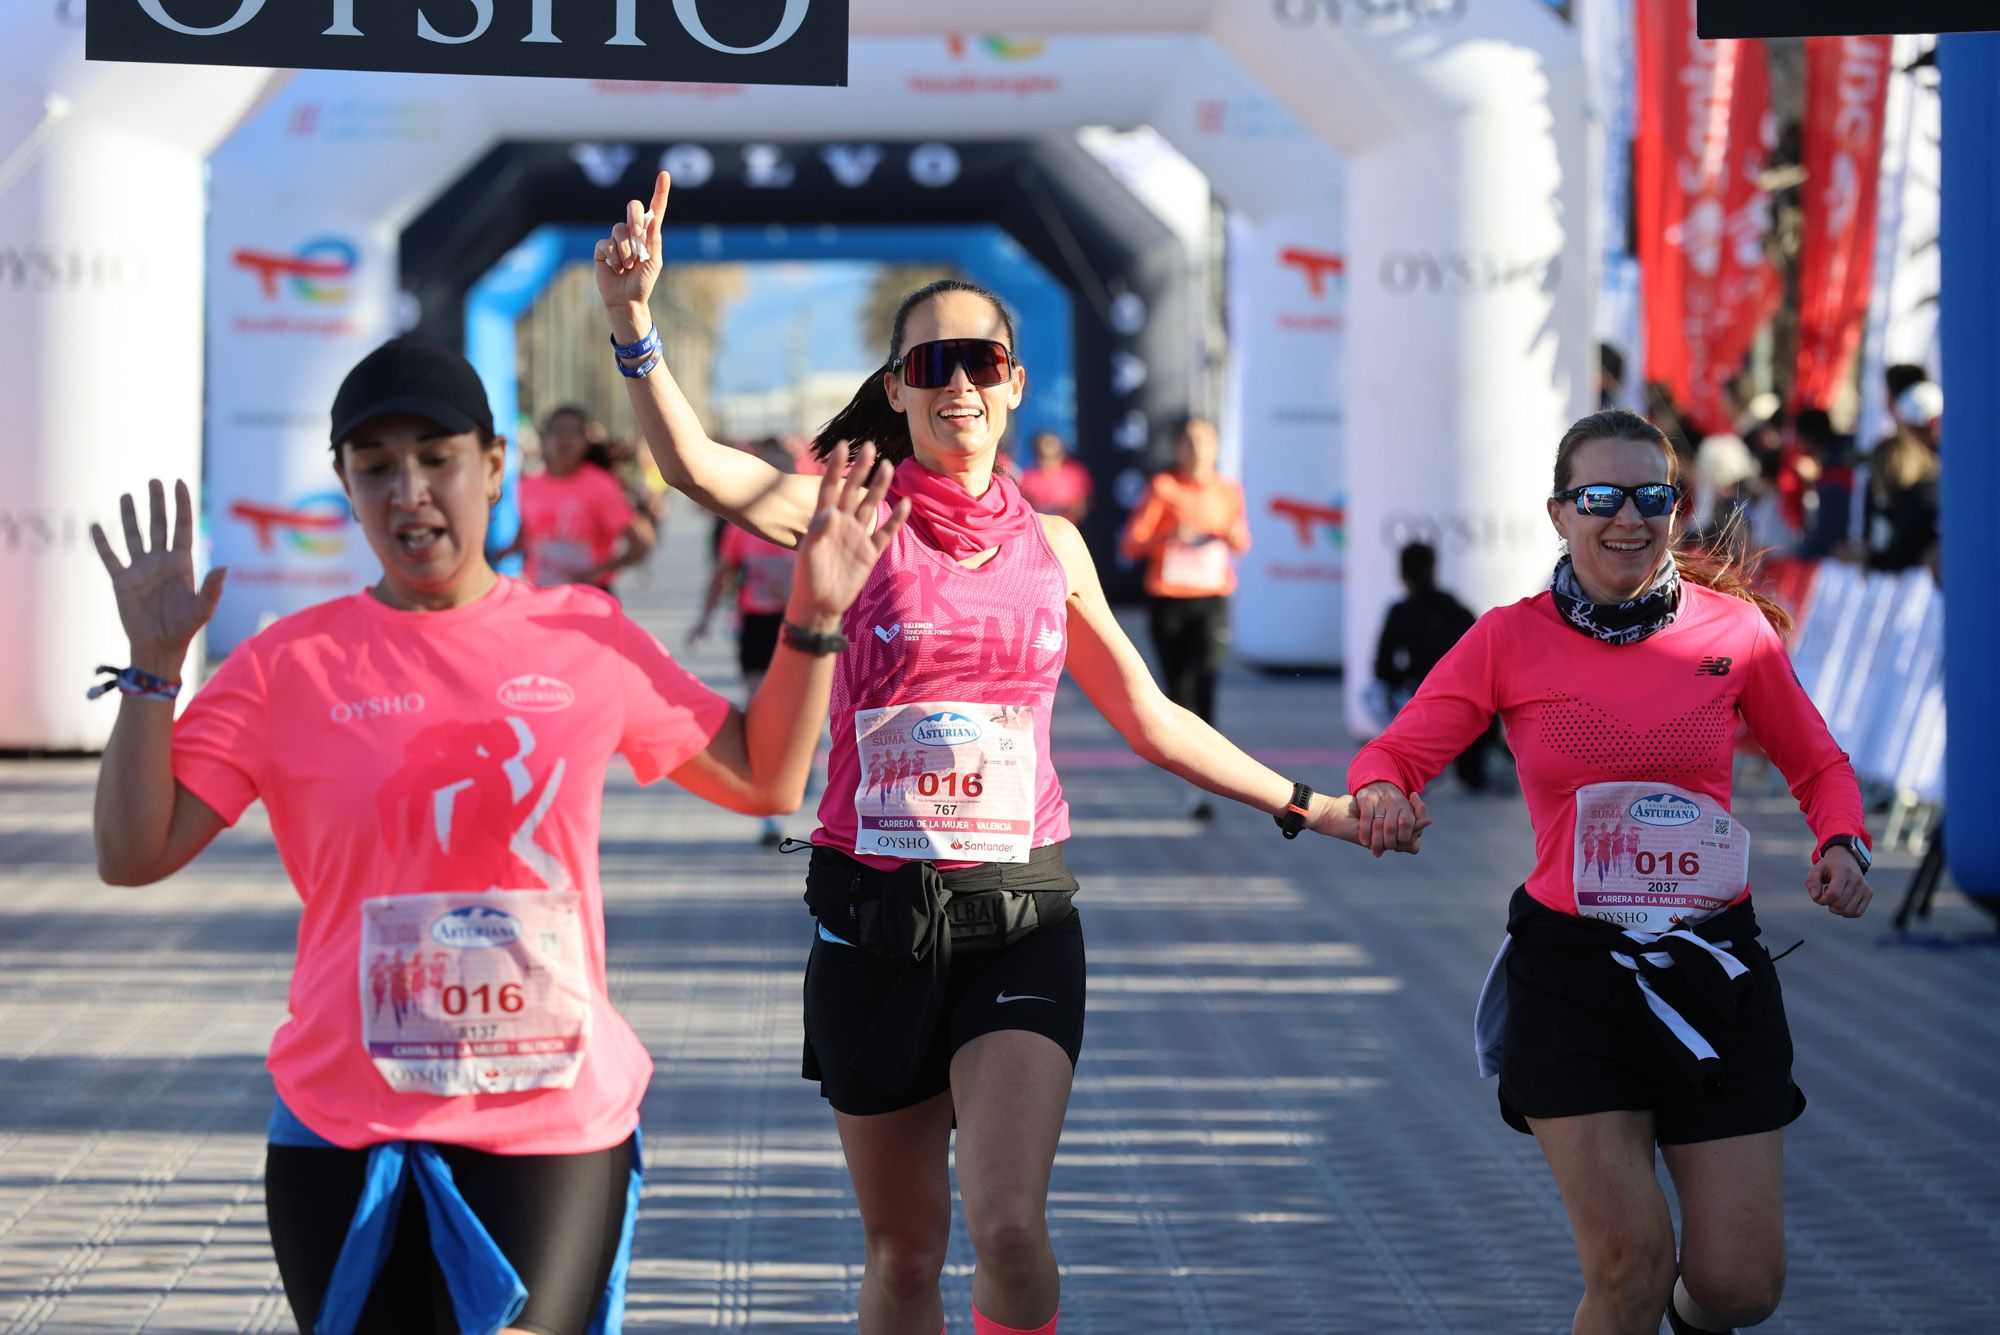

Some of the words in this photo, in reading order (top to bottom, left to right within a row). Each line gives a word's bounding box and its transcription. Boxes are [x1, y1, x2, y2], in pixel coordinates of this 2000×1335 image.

[569, 142, 962, 189] VOLVO
[330, 692, 425, 723] OYSHO
[917, 726, 977, 740] ASTURIANA
[872, 735, 906, 747] SUMA
[917, 772, 983, 797] 016
[934, 804, 957, 815] 767
[1634, 805, 1695, 818] ASTURIANA
[879, 819, 914, 828] CARRERA
[916, 820, 926, 828] DE
[930, 821, 939, 829] LA
[941, 821, 969, 829] MUJER
[976, 822, 1012, 831] VALENCIA
[878, 836, 929, 849] OYSHO
[964, 840, 1014, 852] Santander
[1635, 851, 1700, 875] 016
[1648, 882, 1678, 893] 2037
[1597, 895, 1632, 903] CARRERA
[1647, 896, 1658, 904] LA
[1660, 897, 1686, 905] MUJER
[1597, 911, 1648, 923] OYSHO
[442, 983, 524, 1015] 016
